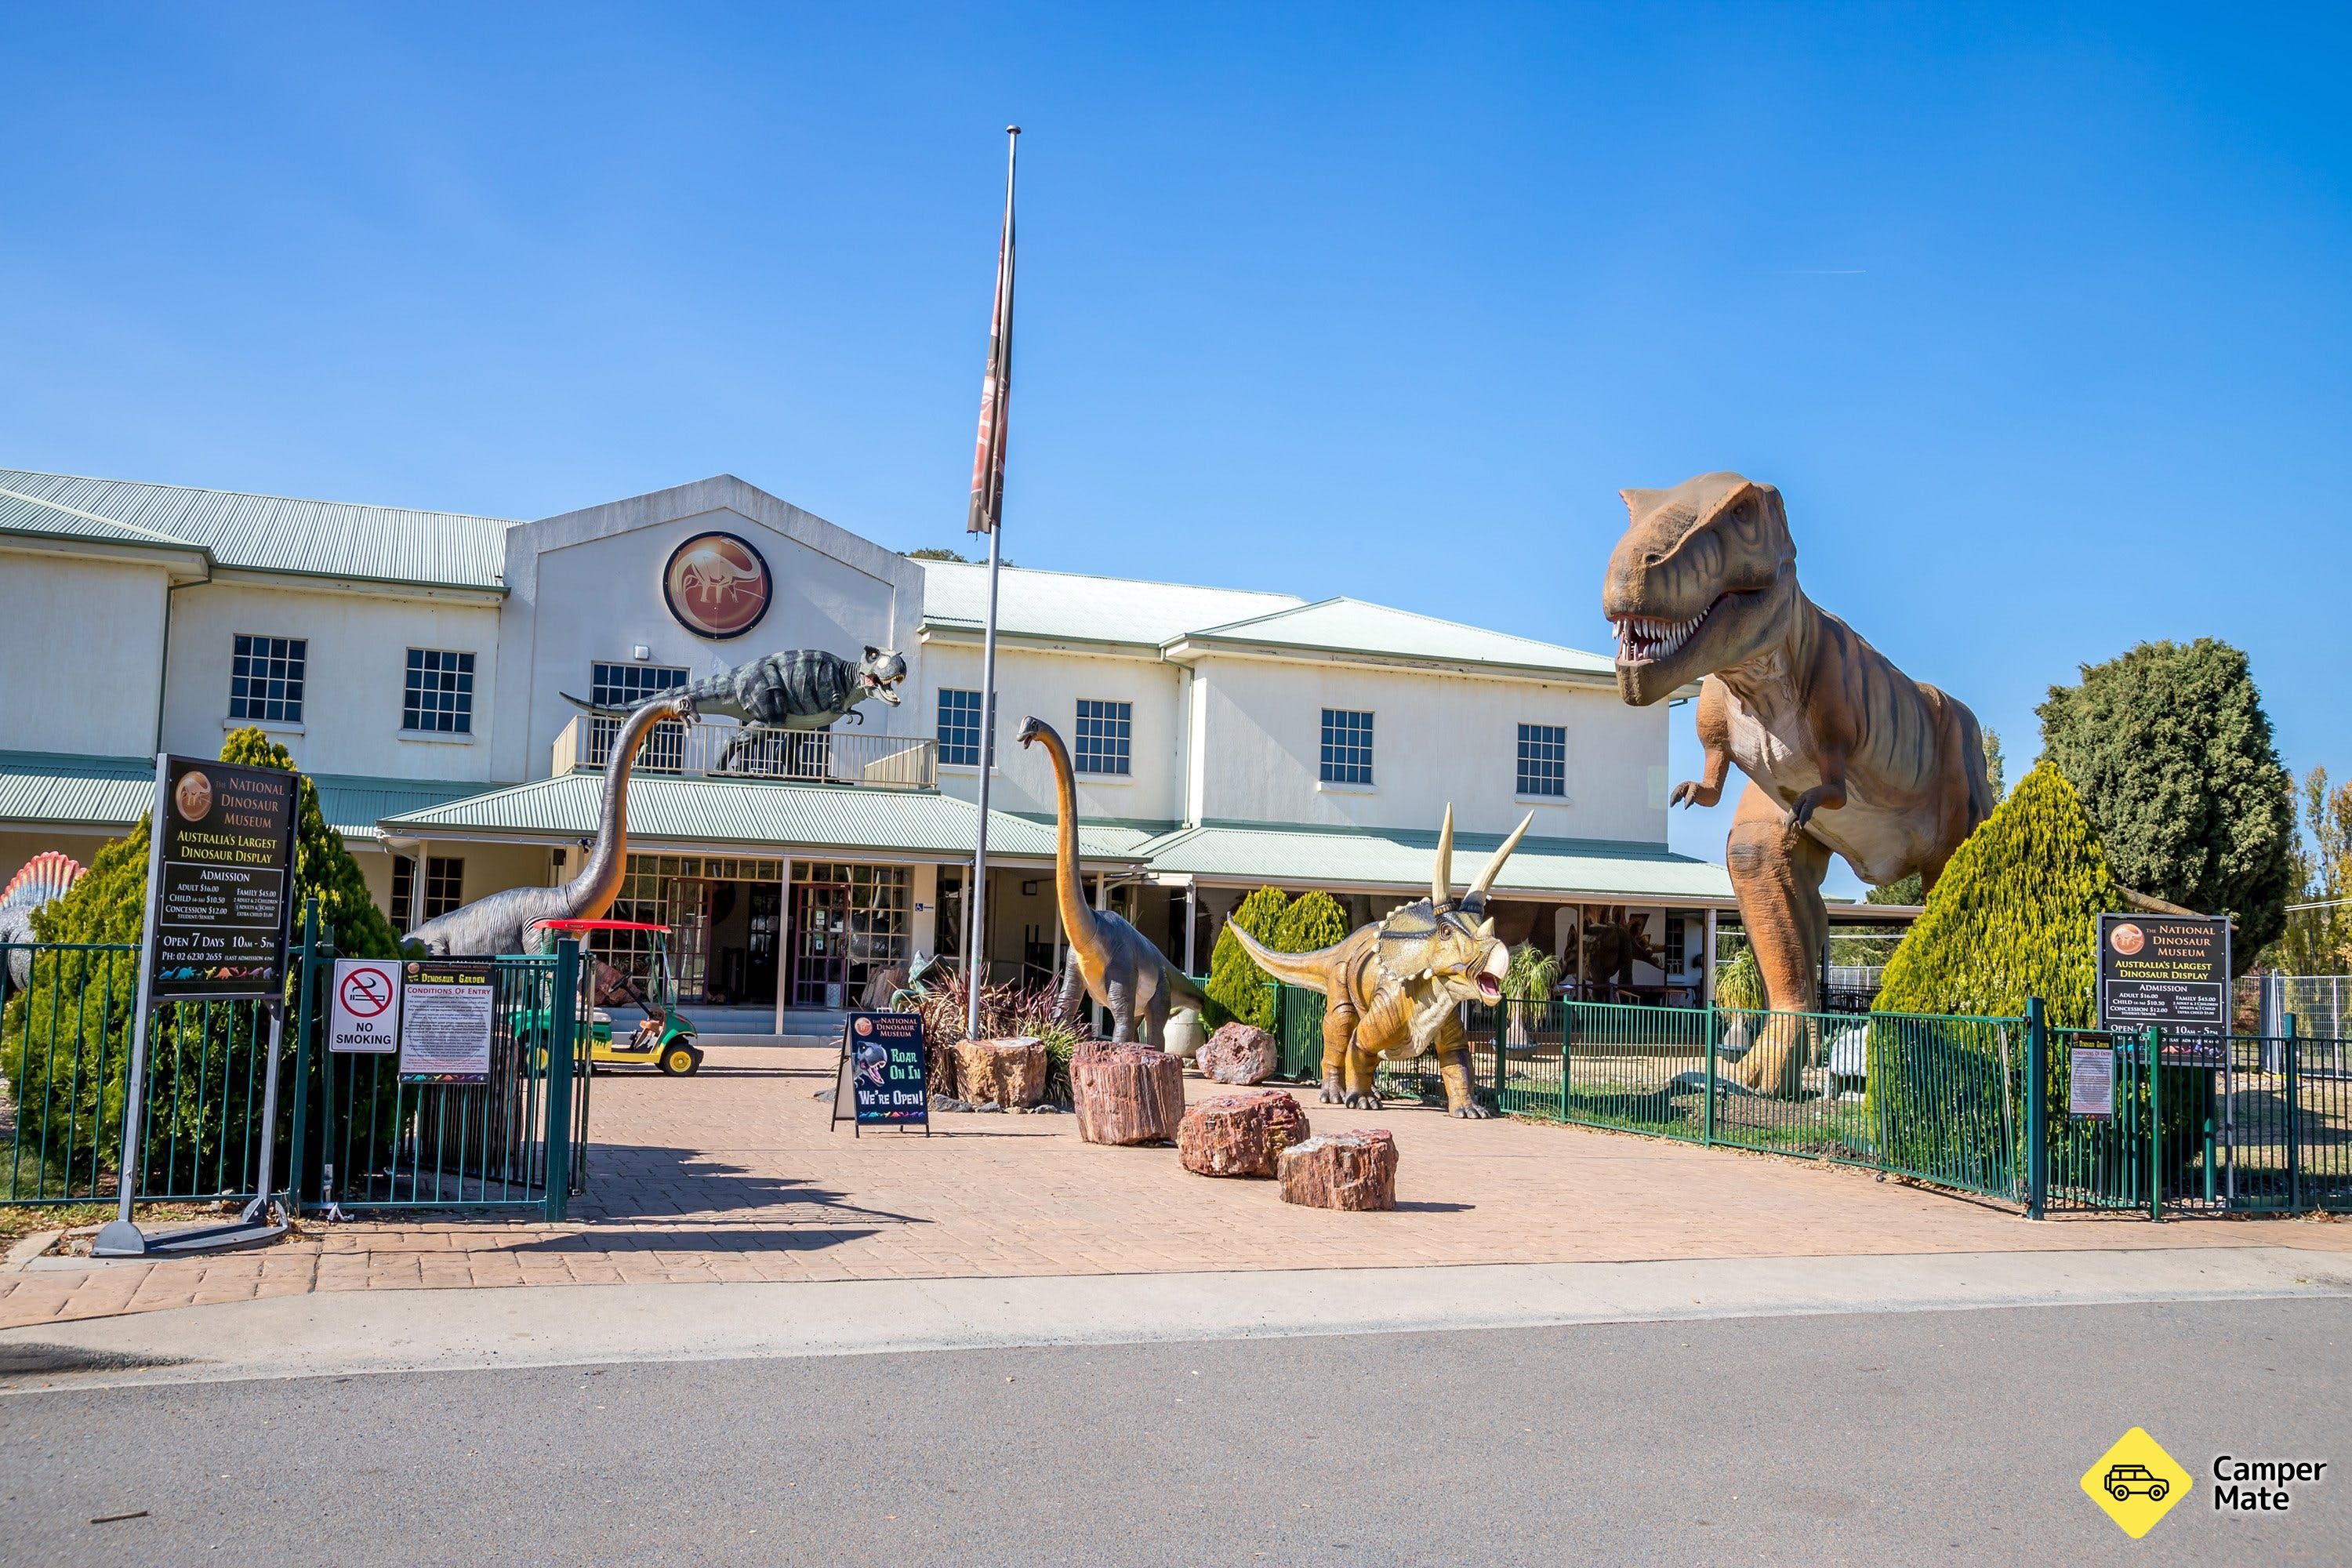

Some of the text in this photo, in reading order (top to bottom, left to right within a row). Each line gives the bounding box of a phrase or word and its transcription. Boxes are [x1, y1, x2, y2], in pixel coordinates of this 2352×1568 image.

[230, 778, 285, 795] NATIONAL
[221, 794, 278, 812] DINOSAUR
[224, 812, 272, 828] MUSEUM
[177, 830, 277, 849] AUSTRALIA'S LARGEST
[181, 846, 272, 864] DINOSAUR DISPLAY
[200, 869, 250, 882] ADMISSION
[177, 883, 219, 892] ADULT $16.00
[237, 888, 276, 897] FAMILY $45.00
[169, 893, 191, 902] CHILD
[206, 895, 225, 904] $10.50
[165, 904, 227, 915] CONCESSION $12.00
[2160, 926, 2216, 935] NATIONAL
[163, 935, 189, 947] OPEN
[192, 933, 200, 947] 7
[202, 936, 225, 947] DAYS
[232, 936, 252, 947] 10AM
[260, 936, 274, 948] 5PM
[2153, 936, 2211, 946] DINOSAUR
[162, 951, 175, 960] PH:
[187, 953, 204, 961] 6230
[205, 953, 222, 961] 2655
[2158, 948, 2205, 957] MUSEUM
[2115, 960, 2212, 970] AUSTRALIA'S LARGEST
[422, 973, 454, 983] DINOSAUR
[459, 974, 485, 984] GARDEN
[2120, 970, 2209, 980] DINOSAUR DISPLAY
[356, 1023, 373, 1032] NO
[2136, 1023, 2144, 1032] 7
[336, 1034, 391, 1044] SMOKING
[891, 1048, 917, 1063] ROAR
[890, 1065, 921, 1080] ON IN
[858, 1090, 924, 1105] WE'RE OPEN!
